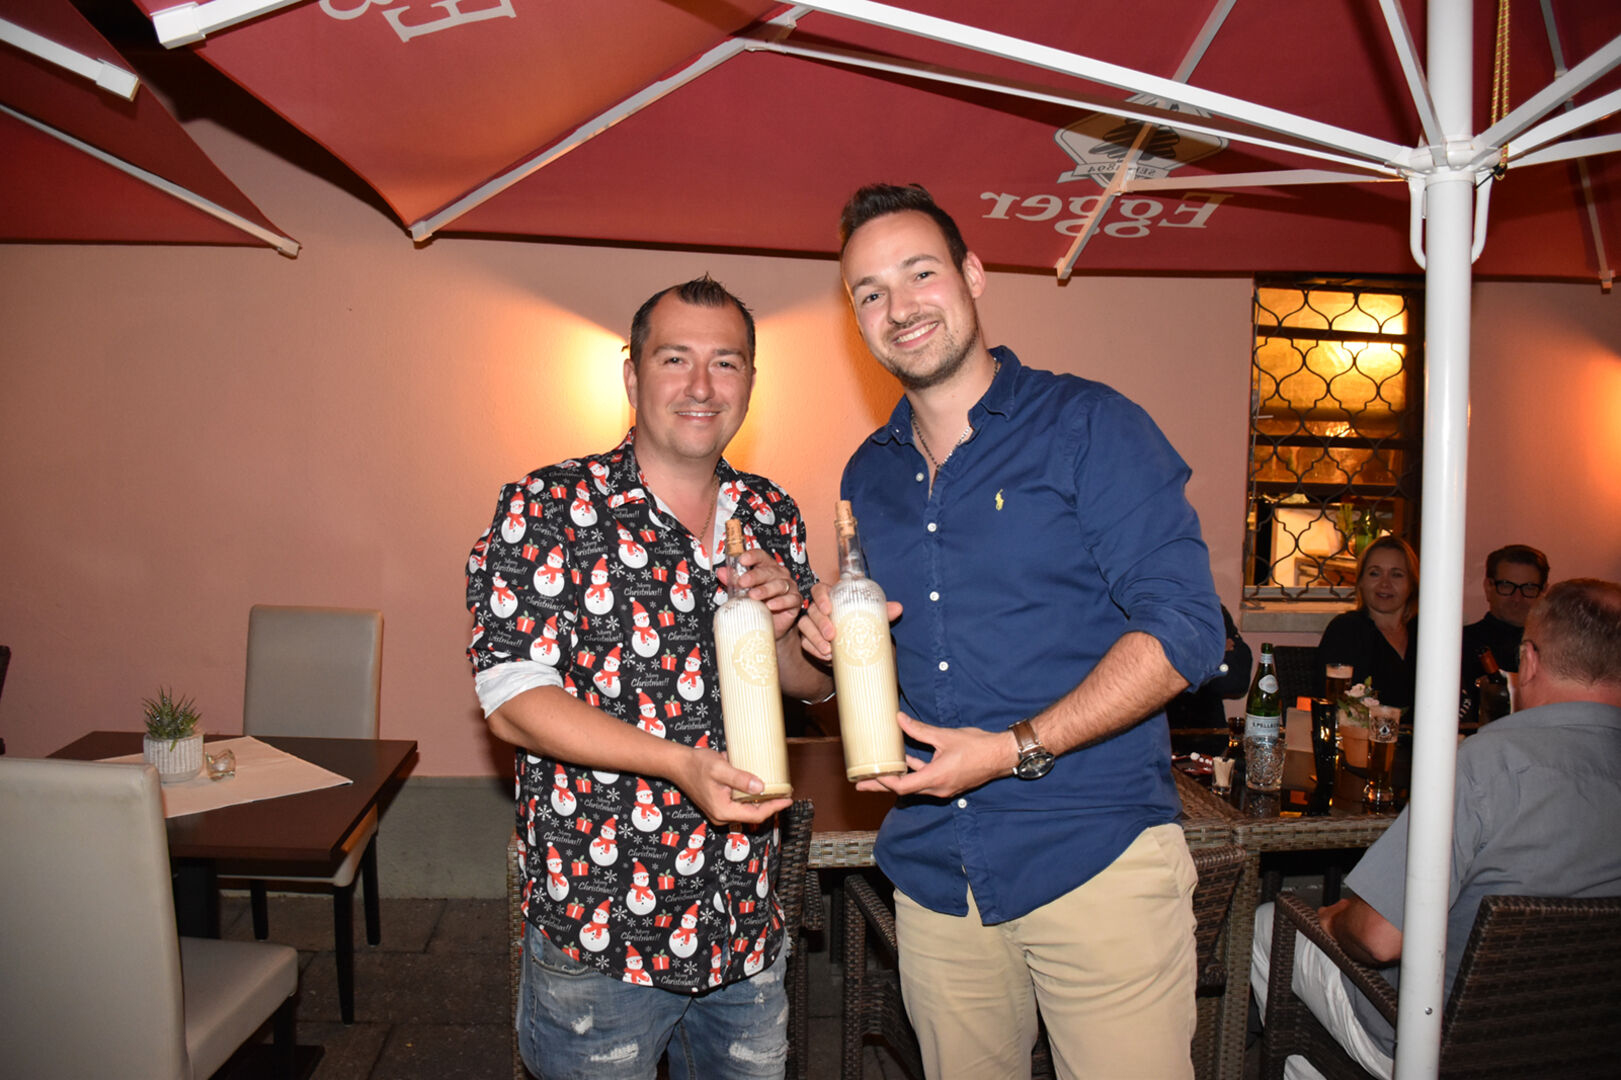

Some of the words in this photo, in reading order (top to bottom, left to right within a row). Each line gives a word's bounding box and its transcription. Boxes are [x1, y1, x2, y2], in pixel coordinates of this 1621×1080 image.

[624, 586, 662, 596] Christmas!!
[631, 677, 669, 687] Christmas!!
[674, 720, 712, 731] Christmas!!
[627, 849, 668, 860] Christmas!!
[578, 882, 618, 896] Christmas!!
[620, 931, 661, 943] Christmas!!
[660, 974, 700, 987] Christmas!!
